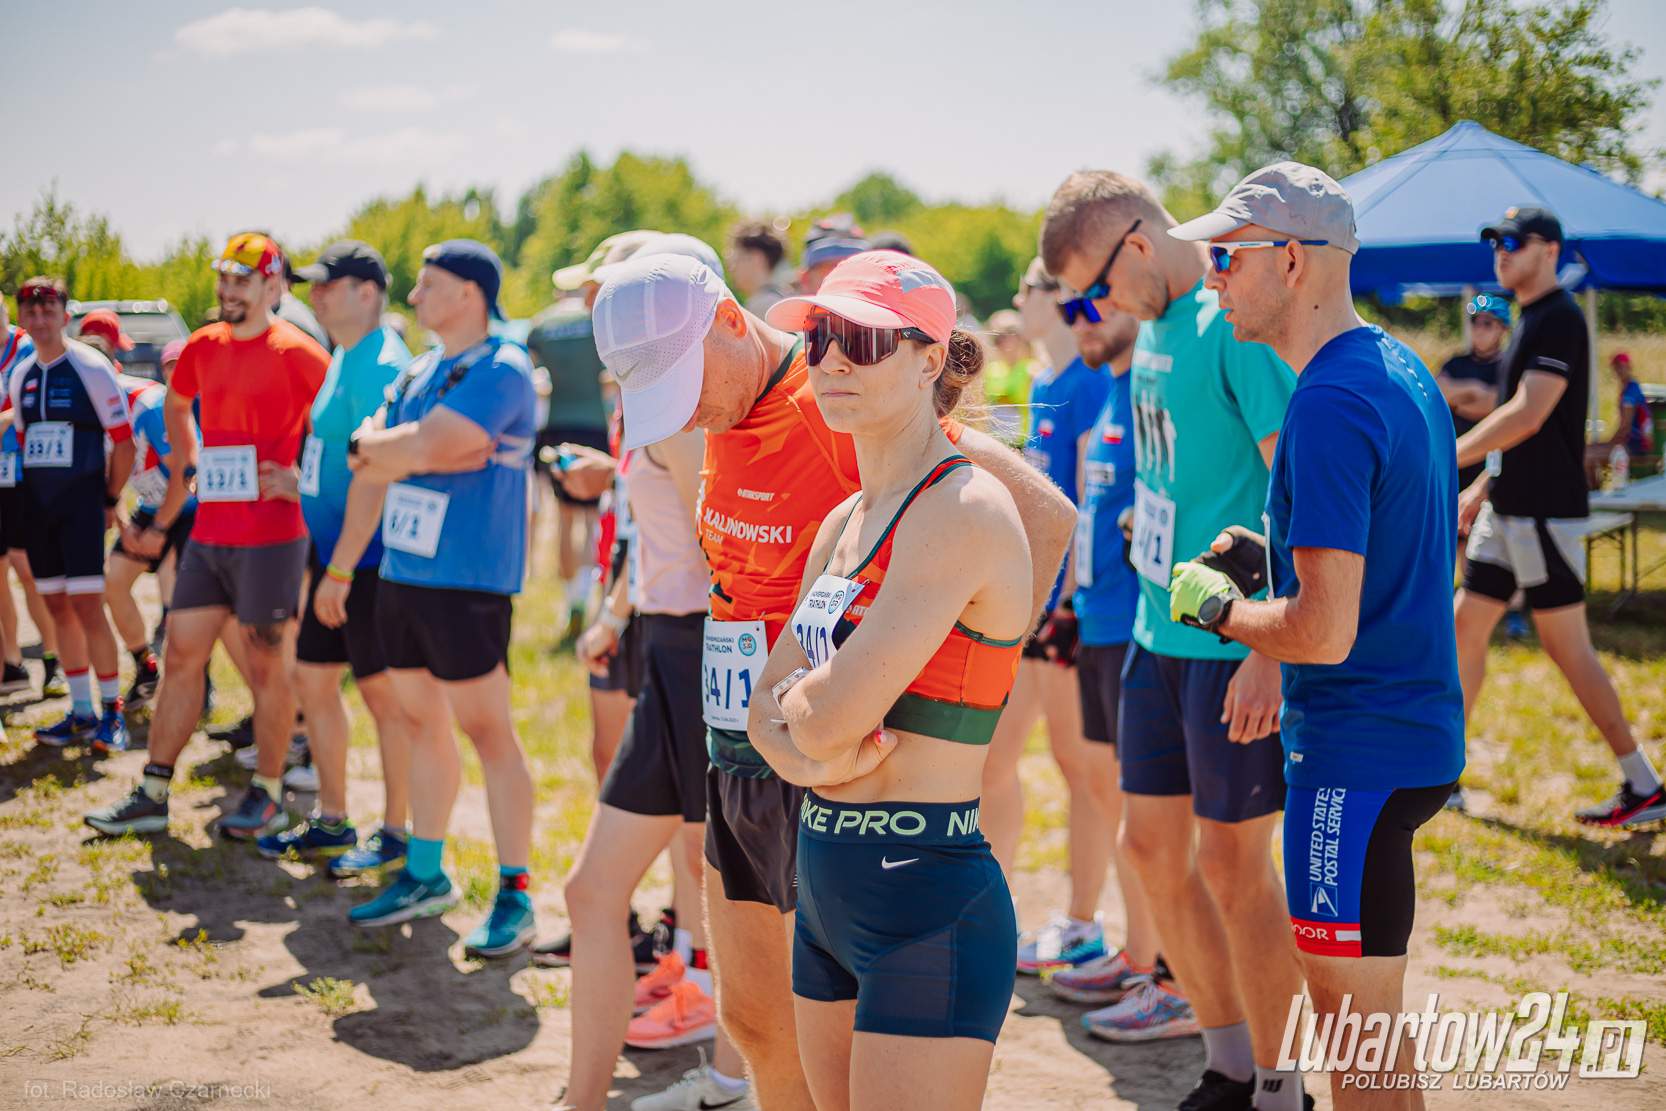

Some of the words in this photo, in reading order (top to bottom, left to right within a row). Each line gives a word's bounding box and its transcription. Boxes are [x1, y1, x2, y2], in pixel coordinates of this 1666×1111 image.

[704, 507, 792, 544] KALINOWSKI
[704, 664, 752, 709] 34/1
[834, 811, 927, 836] PRO
[1309, 830, 1323, 882] UNITED
[1324, 838, 1340, 886] POSTAL
